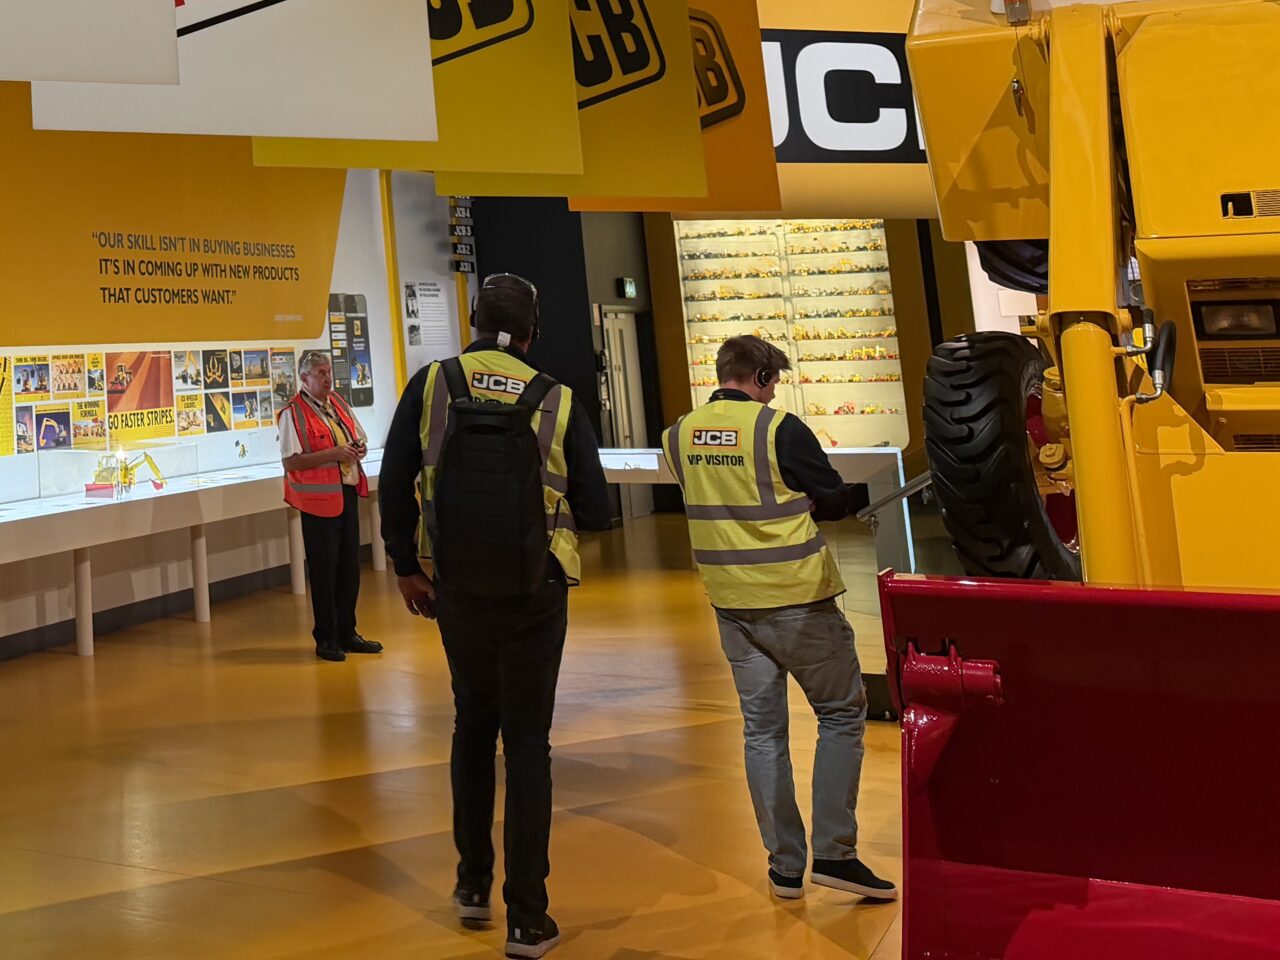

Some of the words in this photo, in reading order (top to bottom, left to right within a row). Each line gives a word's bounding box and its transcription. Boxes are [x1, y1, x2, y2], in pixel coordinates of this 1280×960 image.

[127, 234, 157, 251] SKILL
[189, 238, 200, 252] IN
[203, 239, 241, 256] BUYING
[243, 241, 295, 259] BUSINESSES
[123, 259, 136, 275] IN
[138, 260, 182, 277] COMING
[185, 262, 199, 277] UP
[201, 263, 227, 279] WITH
[229, 264, 250, 280] NEW
[253, 265, 300, 281] PRODUCTS
[100, 287, 131, 303] THAT
[134, 287, 199, 304] CUSTOMERS
[473, 373, 526, 394] JCB
[108, 415, 119, 430] GO
[121, 412, 145, 428] FASTER
[147, 409, 174, 427] STRIPES.
[694, 431, 737, 446] JCB
[688, 454, 703, 465] VIP
[705, 455, 744, 466] VISITOR
